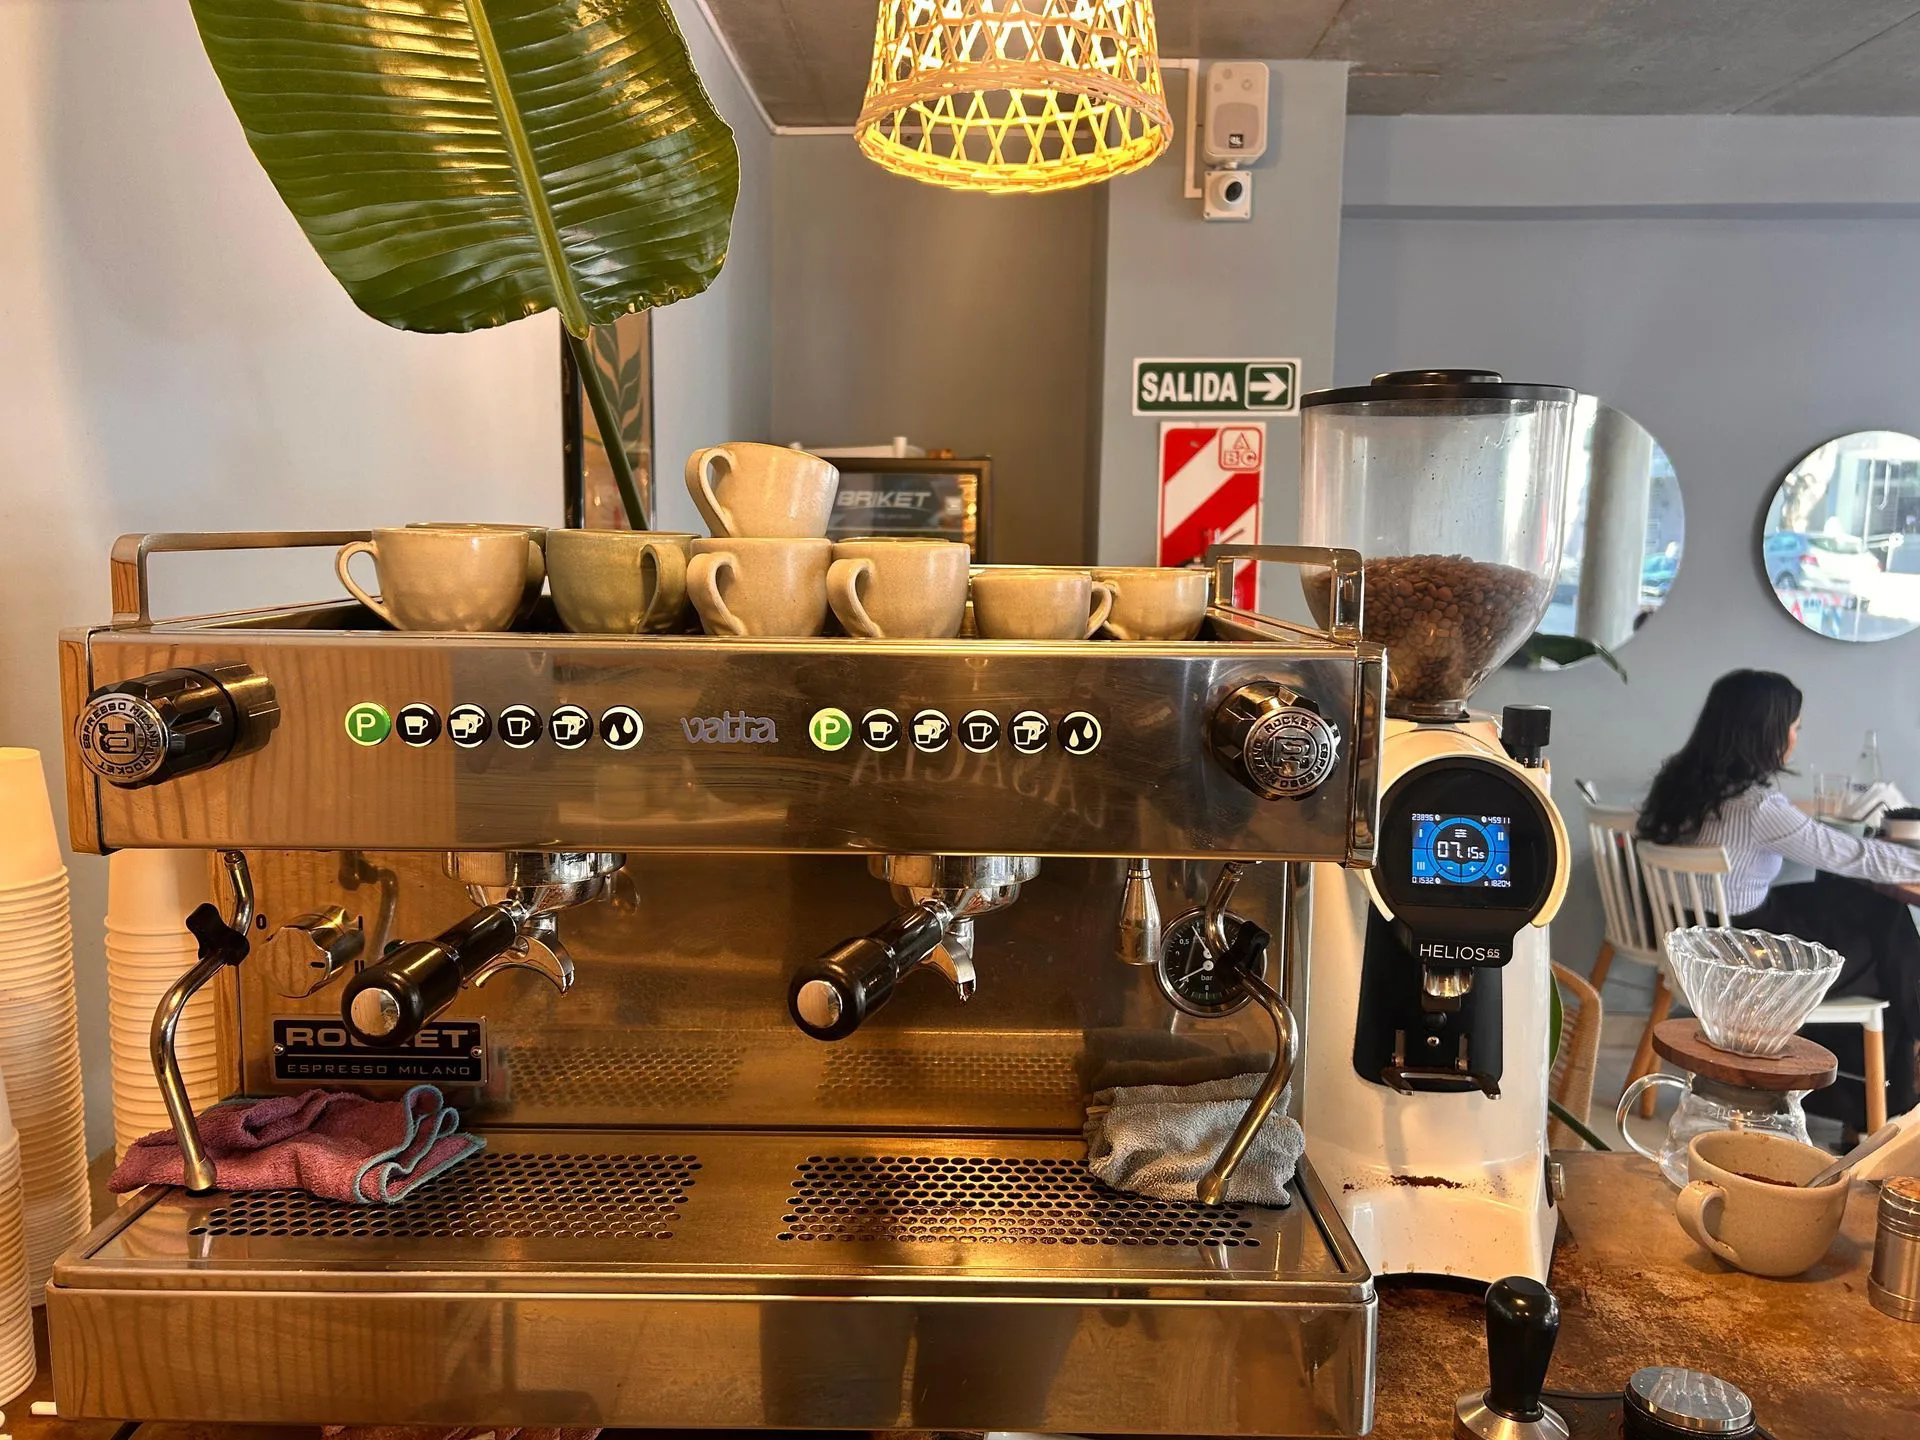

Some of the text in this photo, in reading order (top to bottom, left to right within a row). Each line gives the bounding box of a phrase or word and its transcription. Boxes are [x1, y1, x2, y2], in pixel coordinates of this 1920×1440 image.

[1142, 371, 1238, 402] SALIDA
[1233, 432, 1251, 450] A
[836, 490, 932, 508] BRIKET
[83, 702, 127, 750] ESPRESSO
[355, 712, 377, 738] P
[680, 710, 779, 744] vatta
[819, 715, 841, 743] P
[1264, 715, 1318, 734] ROCKET
[98, 758, 151, 775] ROCKET
[1487, 816, 1511, 825] 45911
[1411, 876, 1434, 884] 01532
[1419, 943, 1500, 961] HELIOS 65
[286, 1027, 469, 1049] ROET
[287, 1063, 470, 1076] ESPRESSO MILANO
